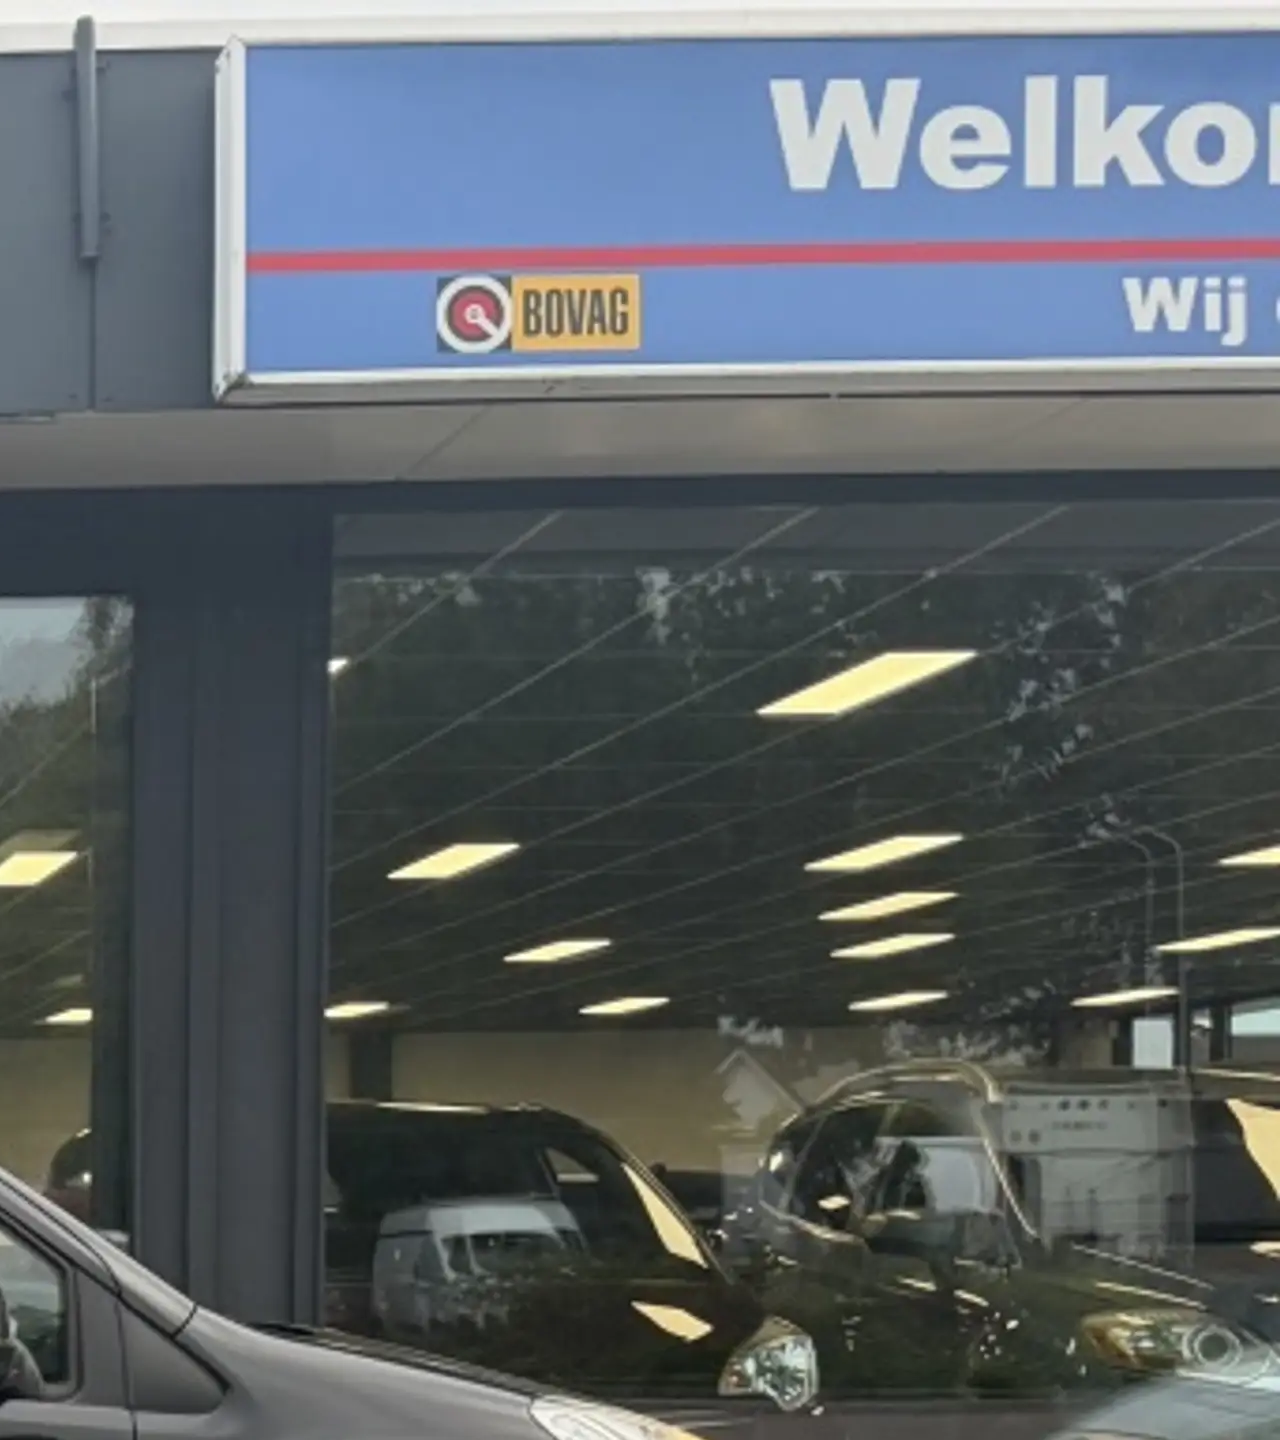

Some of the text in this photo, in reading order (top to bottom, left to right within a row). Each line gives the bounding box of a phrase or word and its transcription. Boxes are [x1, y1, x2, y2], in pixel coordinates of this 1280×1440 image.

[769, 75, 1280, 190] Welko
[522, 284, 630, 338] BOVAG
[1122, 276, 1247, 346] Wij
